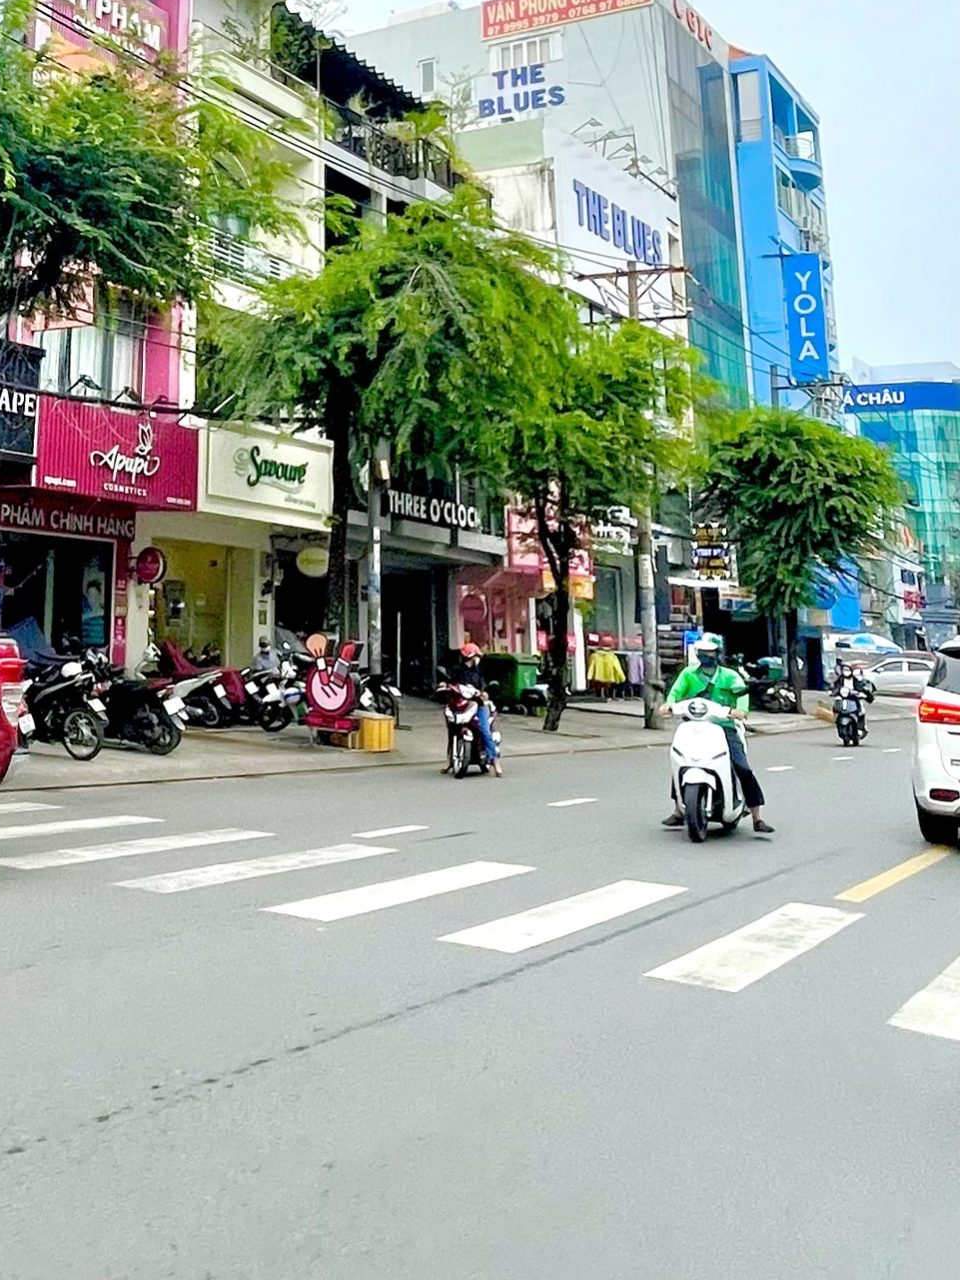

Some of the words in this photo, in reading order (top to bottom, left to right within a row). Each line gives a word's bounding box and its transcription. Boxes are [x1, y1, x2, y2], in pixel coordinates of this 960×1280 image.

[599, 1, 612, 13] 97
[492, 63, 546, 90] THE
[478, 85, 566, 118] BLUES
[573, 178, 611, 241] THE
[611, 202, 663, 267] BLUES
[793, 271, 820, 361] YOLA
[856, 388, 905, 406] CHÂU
[90, 445, 160, 484] Apupi
[103, 482, 148, 497] COSMETICS
[388, 489, 427, 519] THREE
